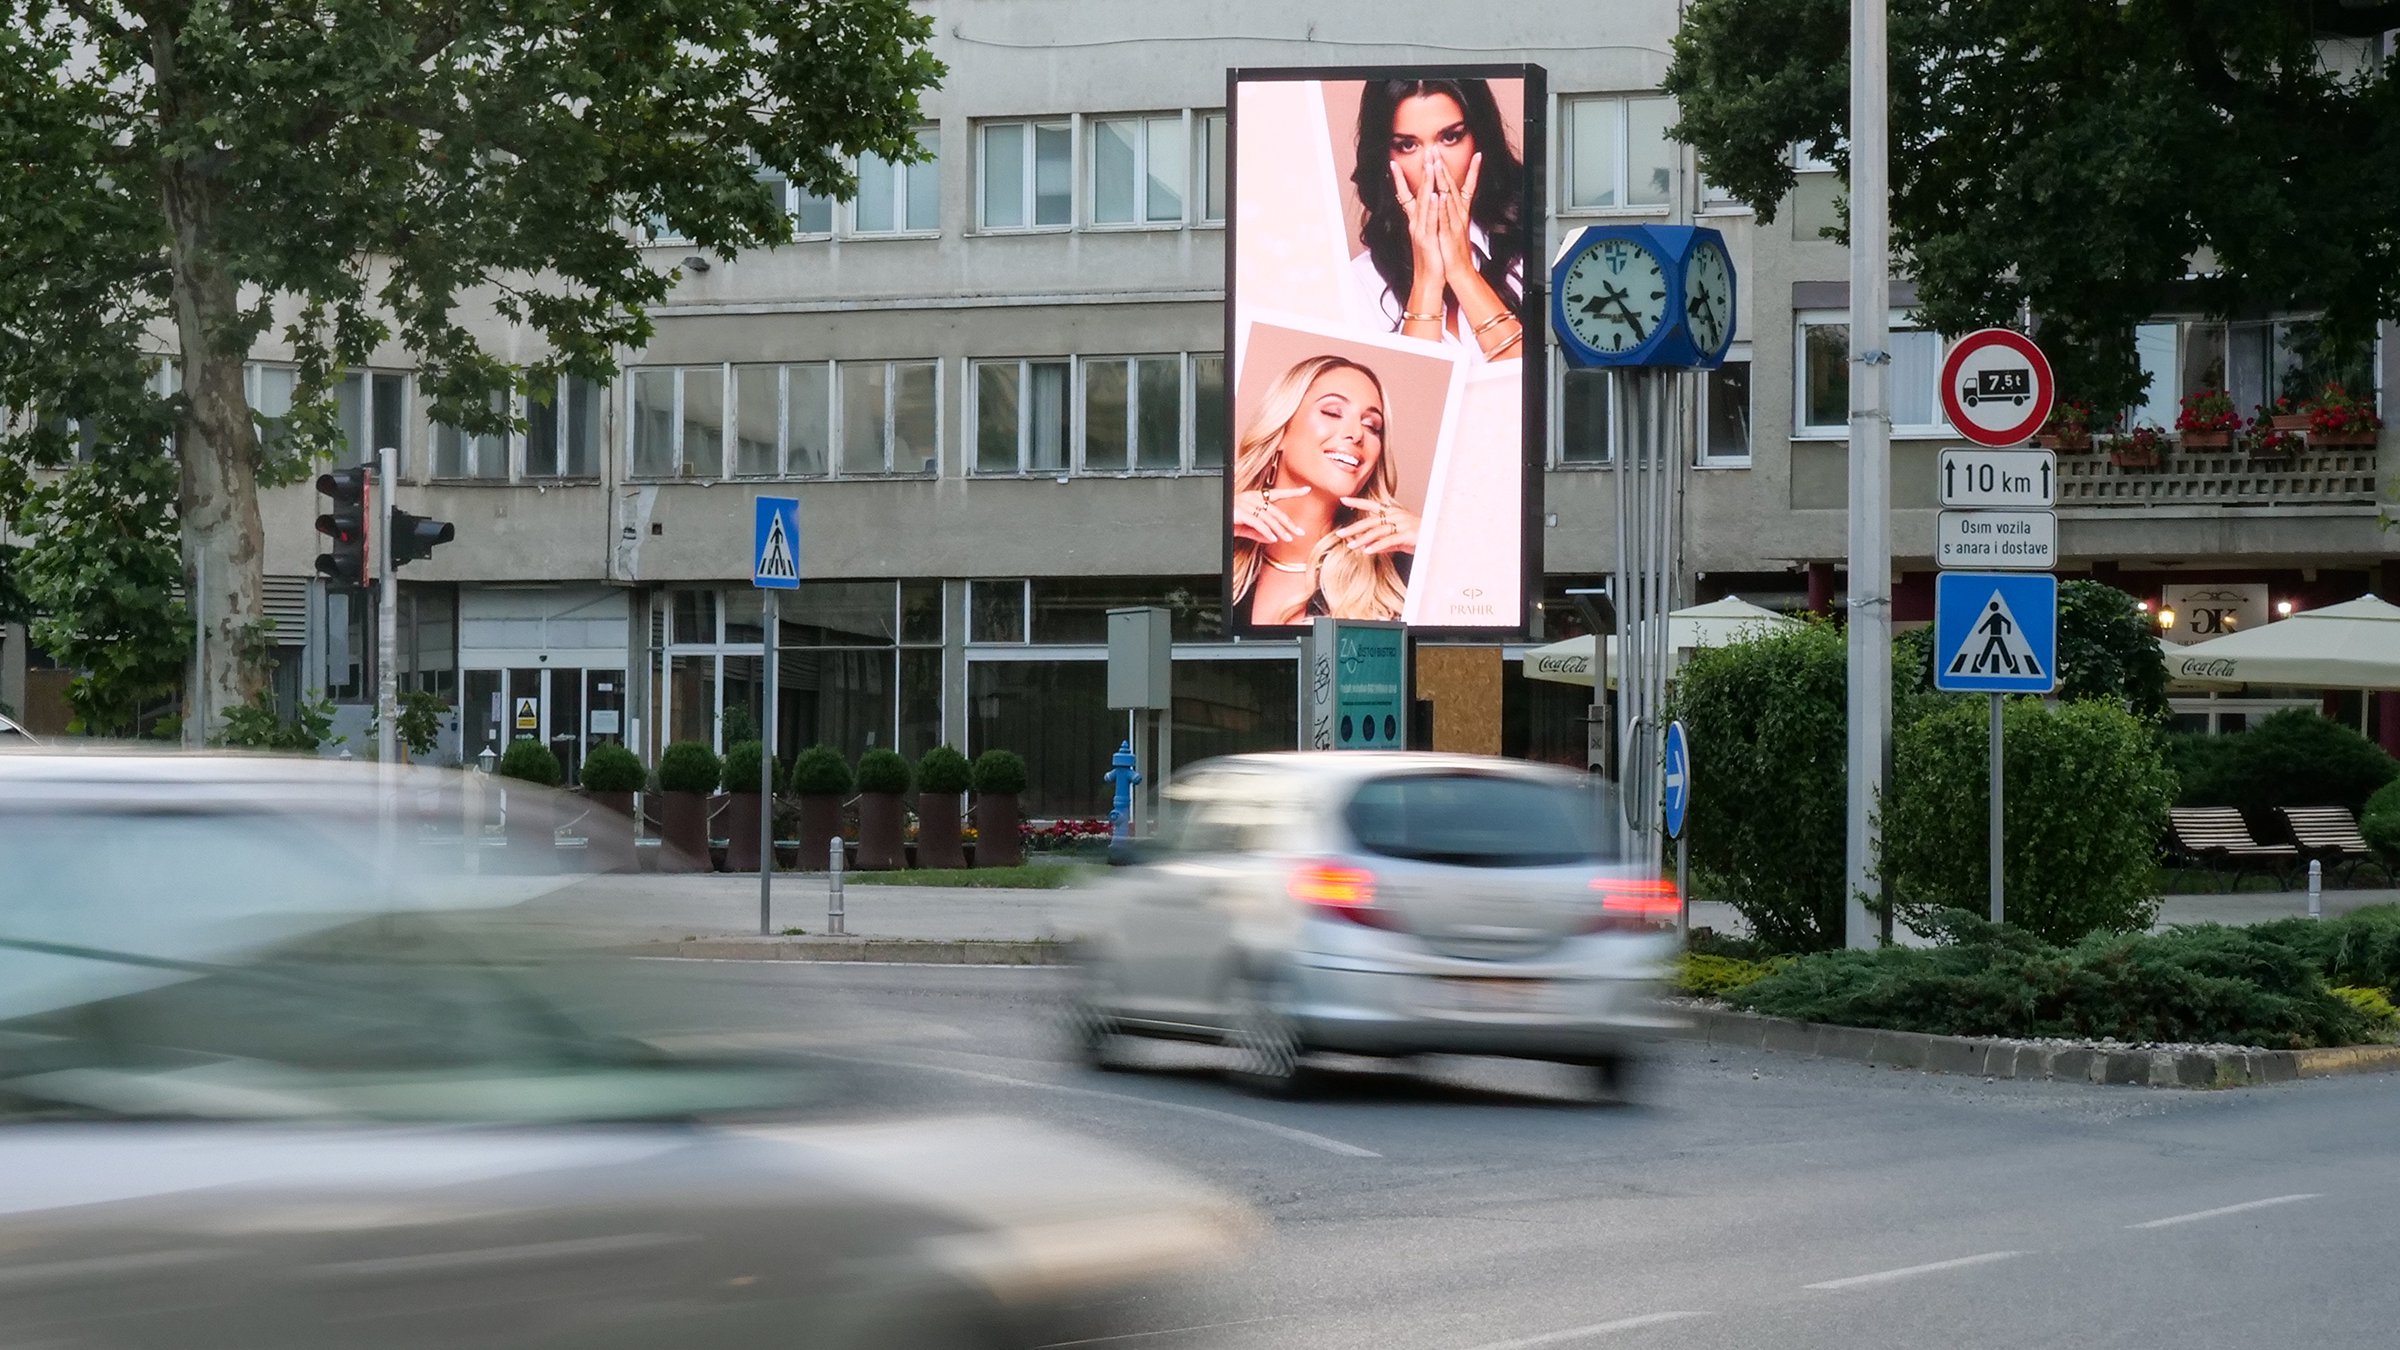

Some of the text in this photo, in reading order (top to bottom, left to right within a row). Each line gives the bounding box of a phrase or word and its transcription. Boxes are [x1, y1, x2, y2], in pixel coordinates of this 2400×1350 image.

[1966, 464, 2031, 492] 10 km
[1996, 520, 2031, 534] vozila
[1994, 541, 1998, 554] i
[2002, 541, 2048, 554] dostave
[1450, 604, 1494, 615] PRAHIR
